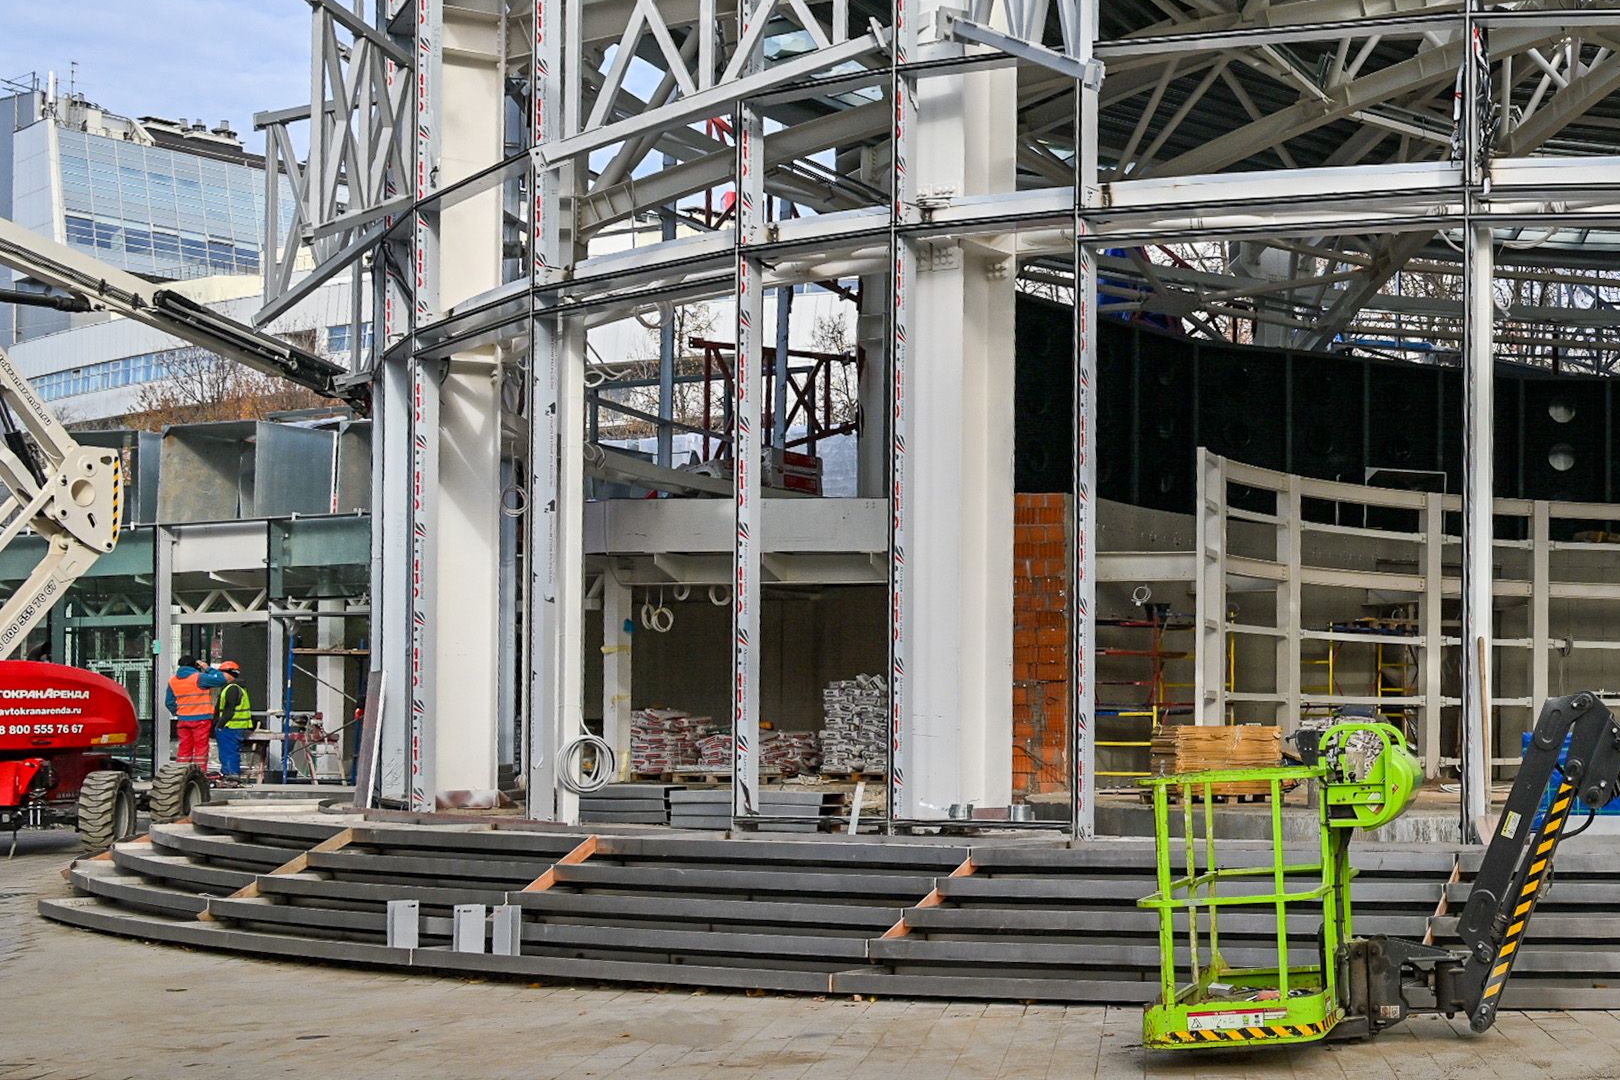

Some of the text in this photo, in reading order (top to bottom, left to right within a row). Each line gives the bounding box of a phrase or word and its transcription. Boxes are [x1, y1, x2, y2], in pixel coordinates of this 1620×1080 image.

[3, 579, 57, 645] 800 555 76 67
[0, 688, 90, 699] ОКРАНАРЕНДА
[0, 724, 84, 735] 8 800 555 76 67
